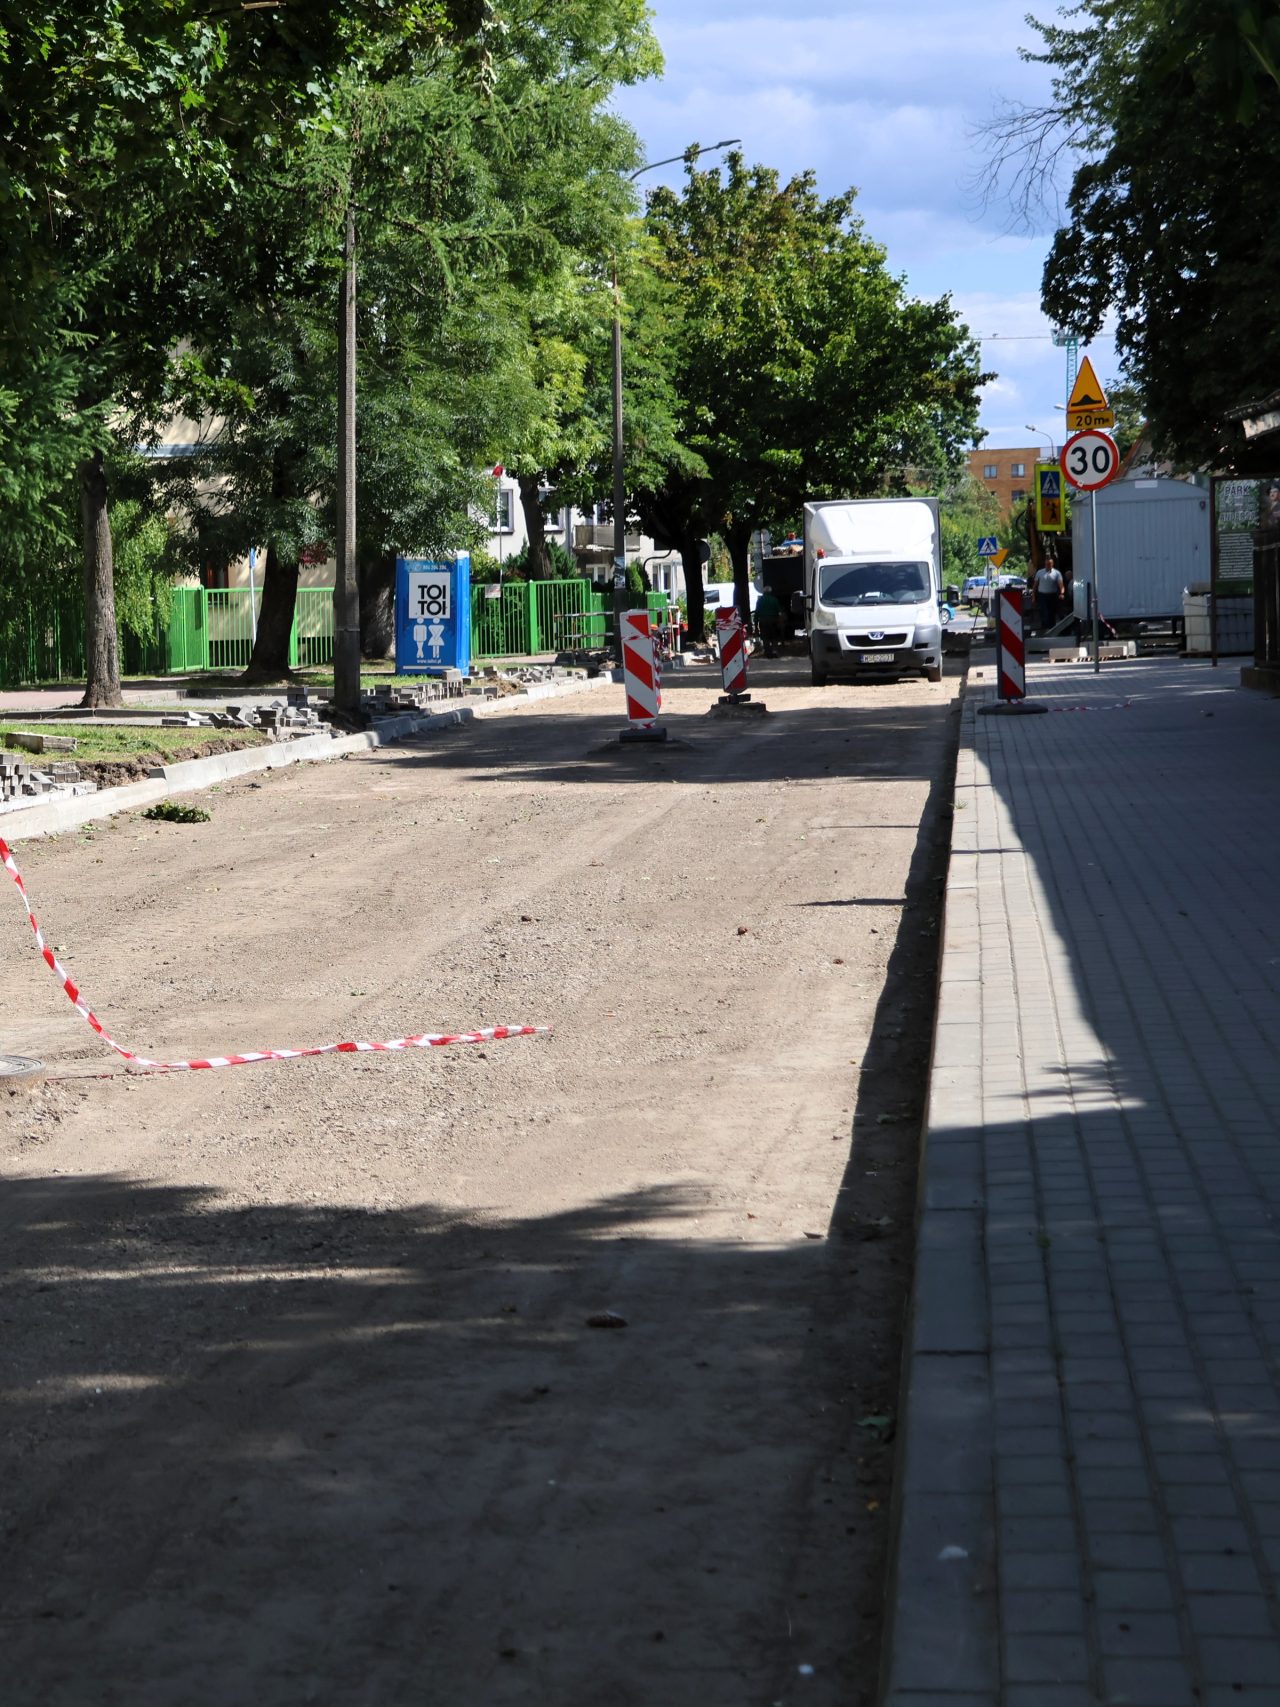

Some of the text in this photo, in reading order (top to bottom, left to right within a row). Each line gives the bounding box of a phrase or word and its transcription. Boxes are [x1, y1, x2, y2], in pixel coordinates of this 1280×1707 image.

[1070, 445, 1110, 476] 30
[1224, 485, 1250, 496] PARK
[417, 584, 446, 600] TOI
[417, 600, 446, 616] TOI
